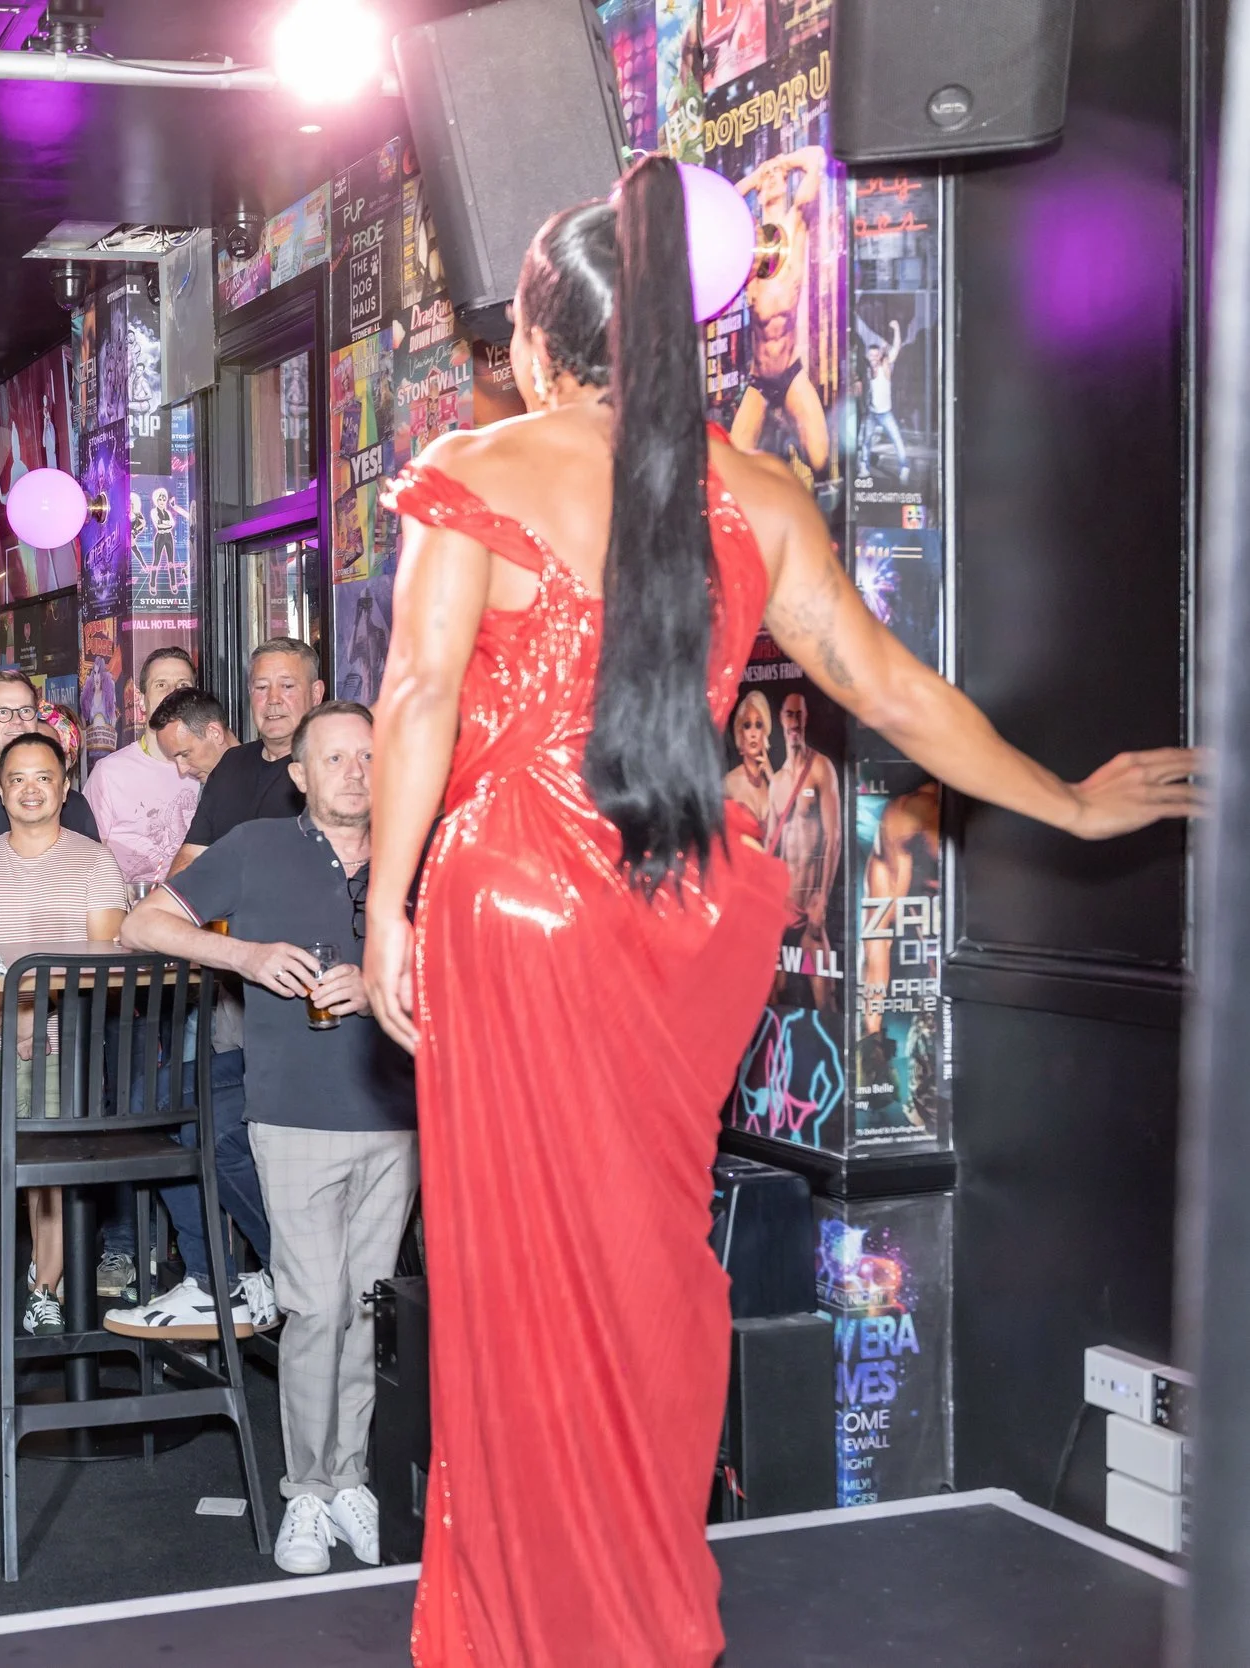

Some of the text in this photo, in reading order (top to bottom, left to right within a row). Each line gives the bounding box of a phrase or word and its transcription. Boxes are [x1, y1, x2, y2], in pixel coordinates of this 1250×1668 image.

[343, 197, 366, 229] PUP
[352, 218, 385, 256] PRIDE
[352, 260, 368, 278] THE
[352, 277, 373, 298] DOG
[352, 296, 377, 321] HAUS
[492, 367, 512, 384] TOGE
[88, 430, 116, 448] STONEWLL
[350, 444, 383, 485] YES!
[151, 618, 176, 630] HOTEL
[743, 664, 779, 682] NESDAYS
[869, 998, 921, 1015] APRIL
[860, 1313, 920, 1359] ERA
